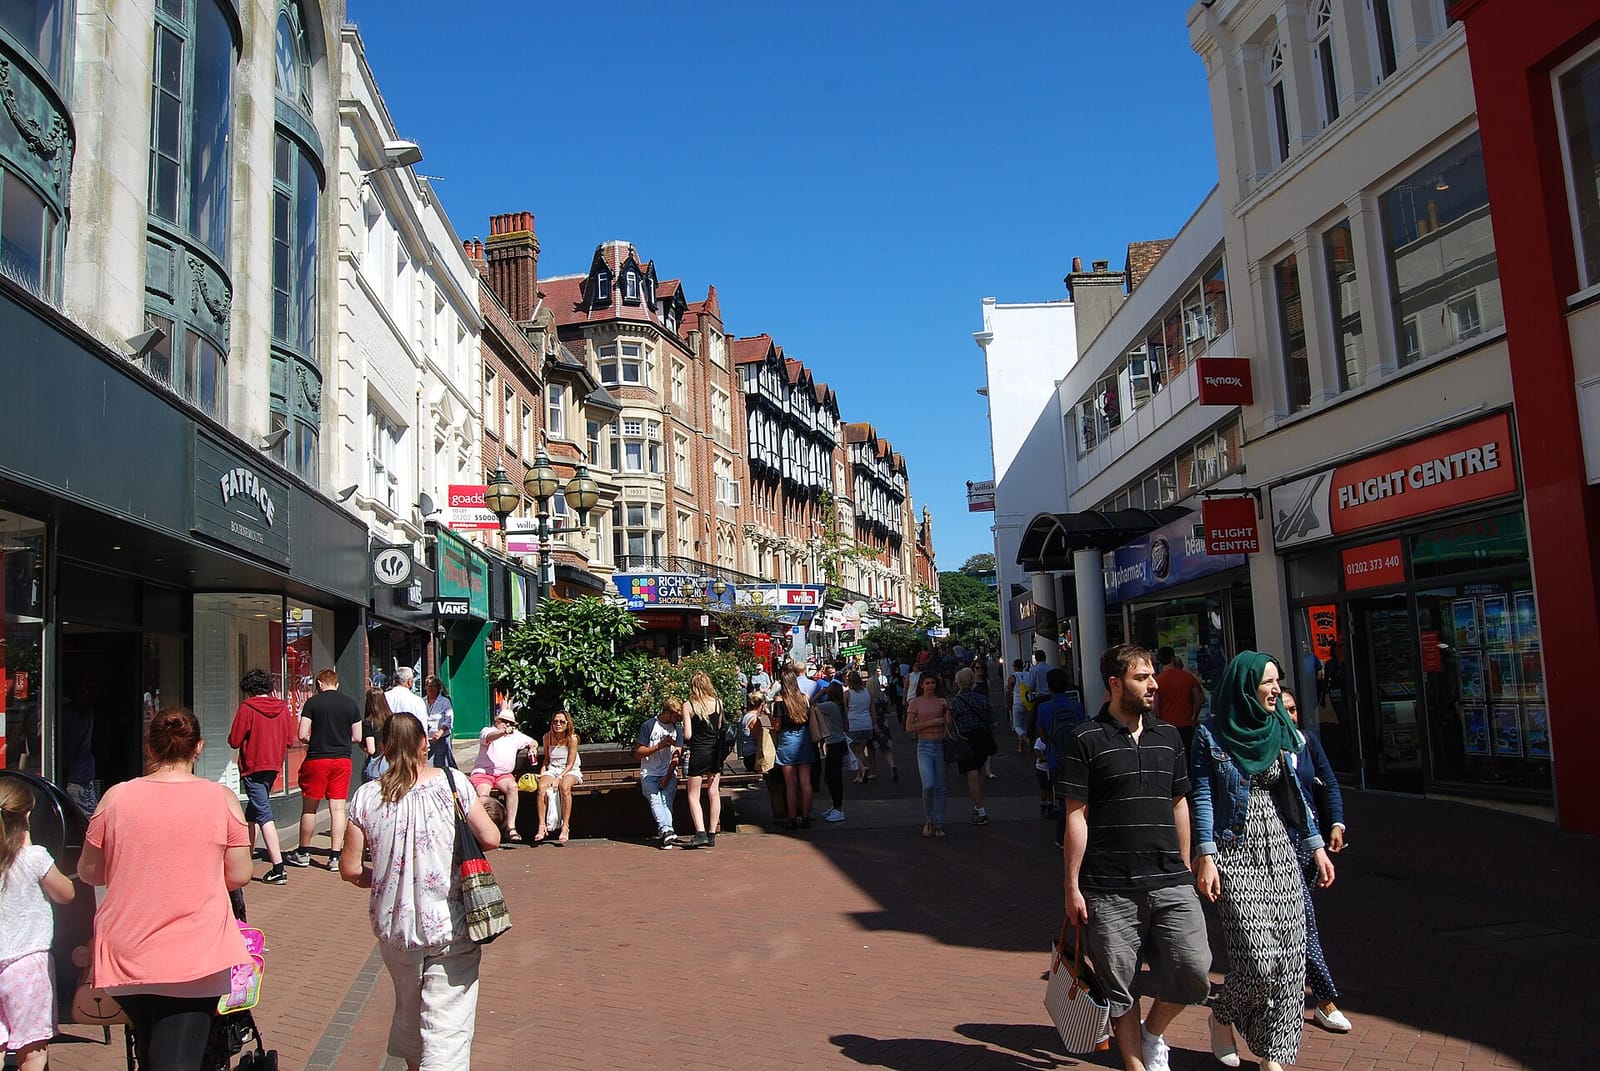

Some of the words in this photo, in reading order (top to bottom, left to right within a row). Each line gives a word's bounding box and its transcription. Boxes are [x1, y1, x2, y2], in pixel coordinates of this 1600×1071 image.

[1338, 469, 1406, 510] FLIGHT
[1408, 443, 1500, 490] CENTRE
[231, 520, 264, 544] BOURNEMOUTH
[1211, 527, 1254, 539] FLIGHT
[1211, 540, 1257, 551] CENTRE
[1346, 561, 1369, 575] 01202
[1369, 558, 1384, 571] 373
[1384, 554, 1400, 568] 440
[1117, 562, 1147, 589] pharmacy
[792, 592, 813, 604] wilko
[437, 601, 469, 615] VANS
